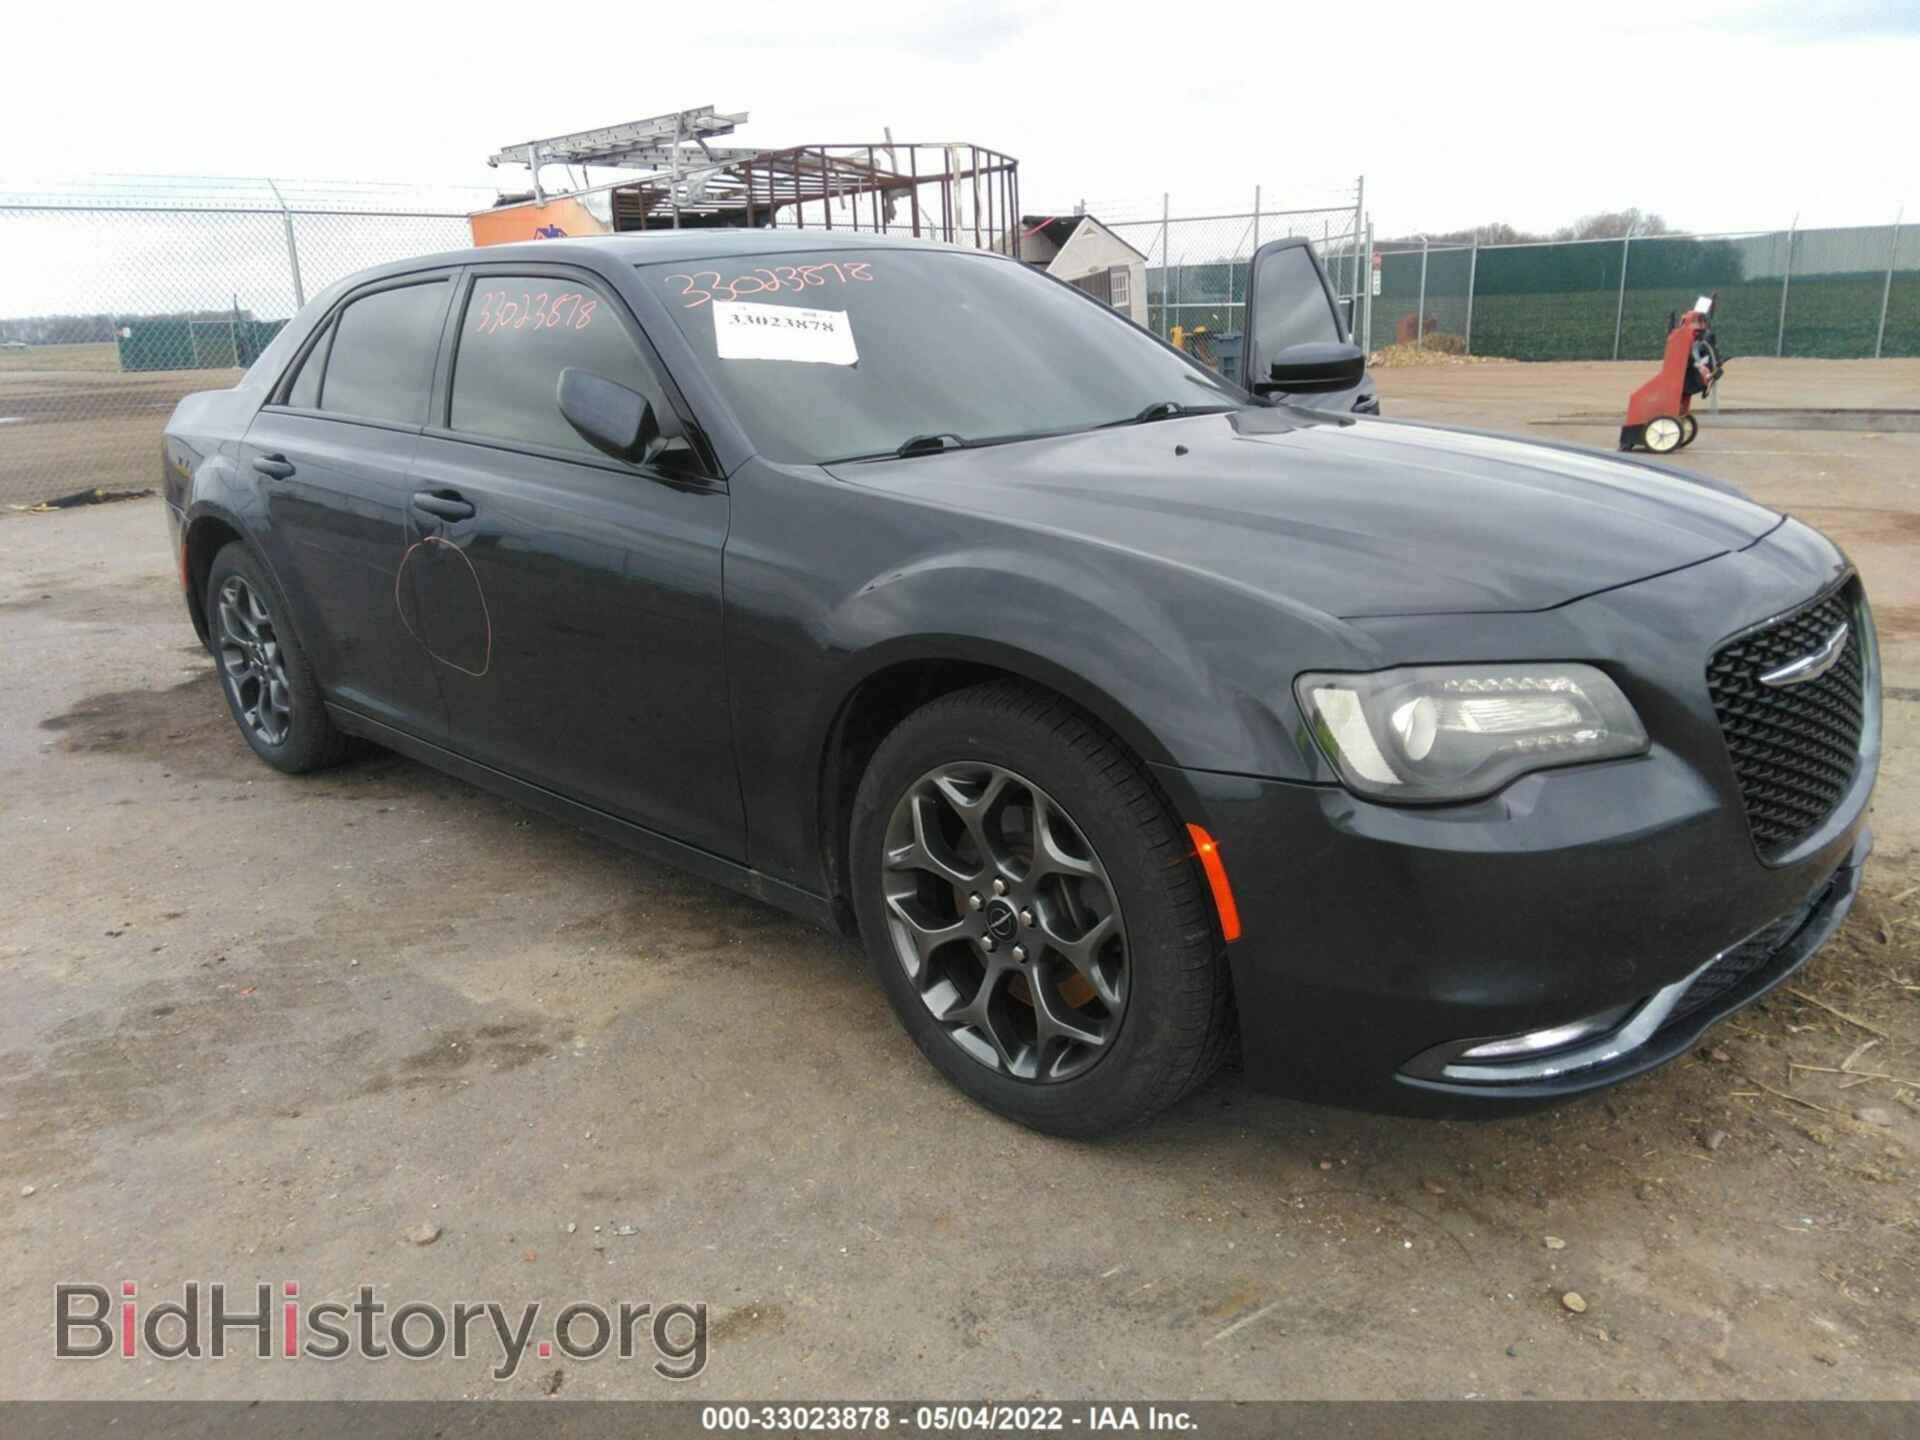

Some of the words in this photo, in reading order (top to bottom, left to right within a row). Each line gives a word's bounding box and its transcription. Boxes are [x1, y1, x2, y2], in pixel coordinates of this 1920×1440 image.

[664, 262, 874, 308] 33023878
[476, 290, 598, 335] 33023878
[728, 312, 836, 332] 33023878
